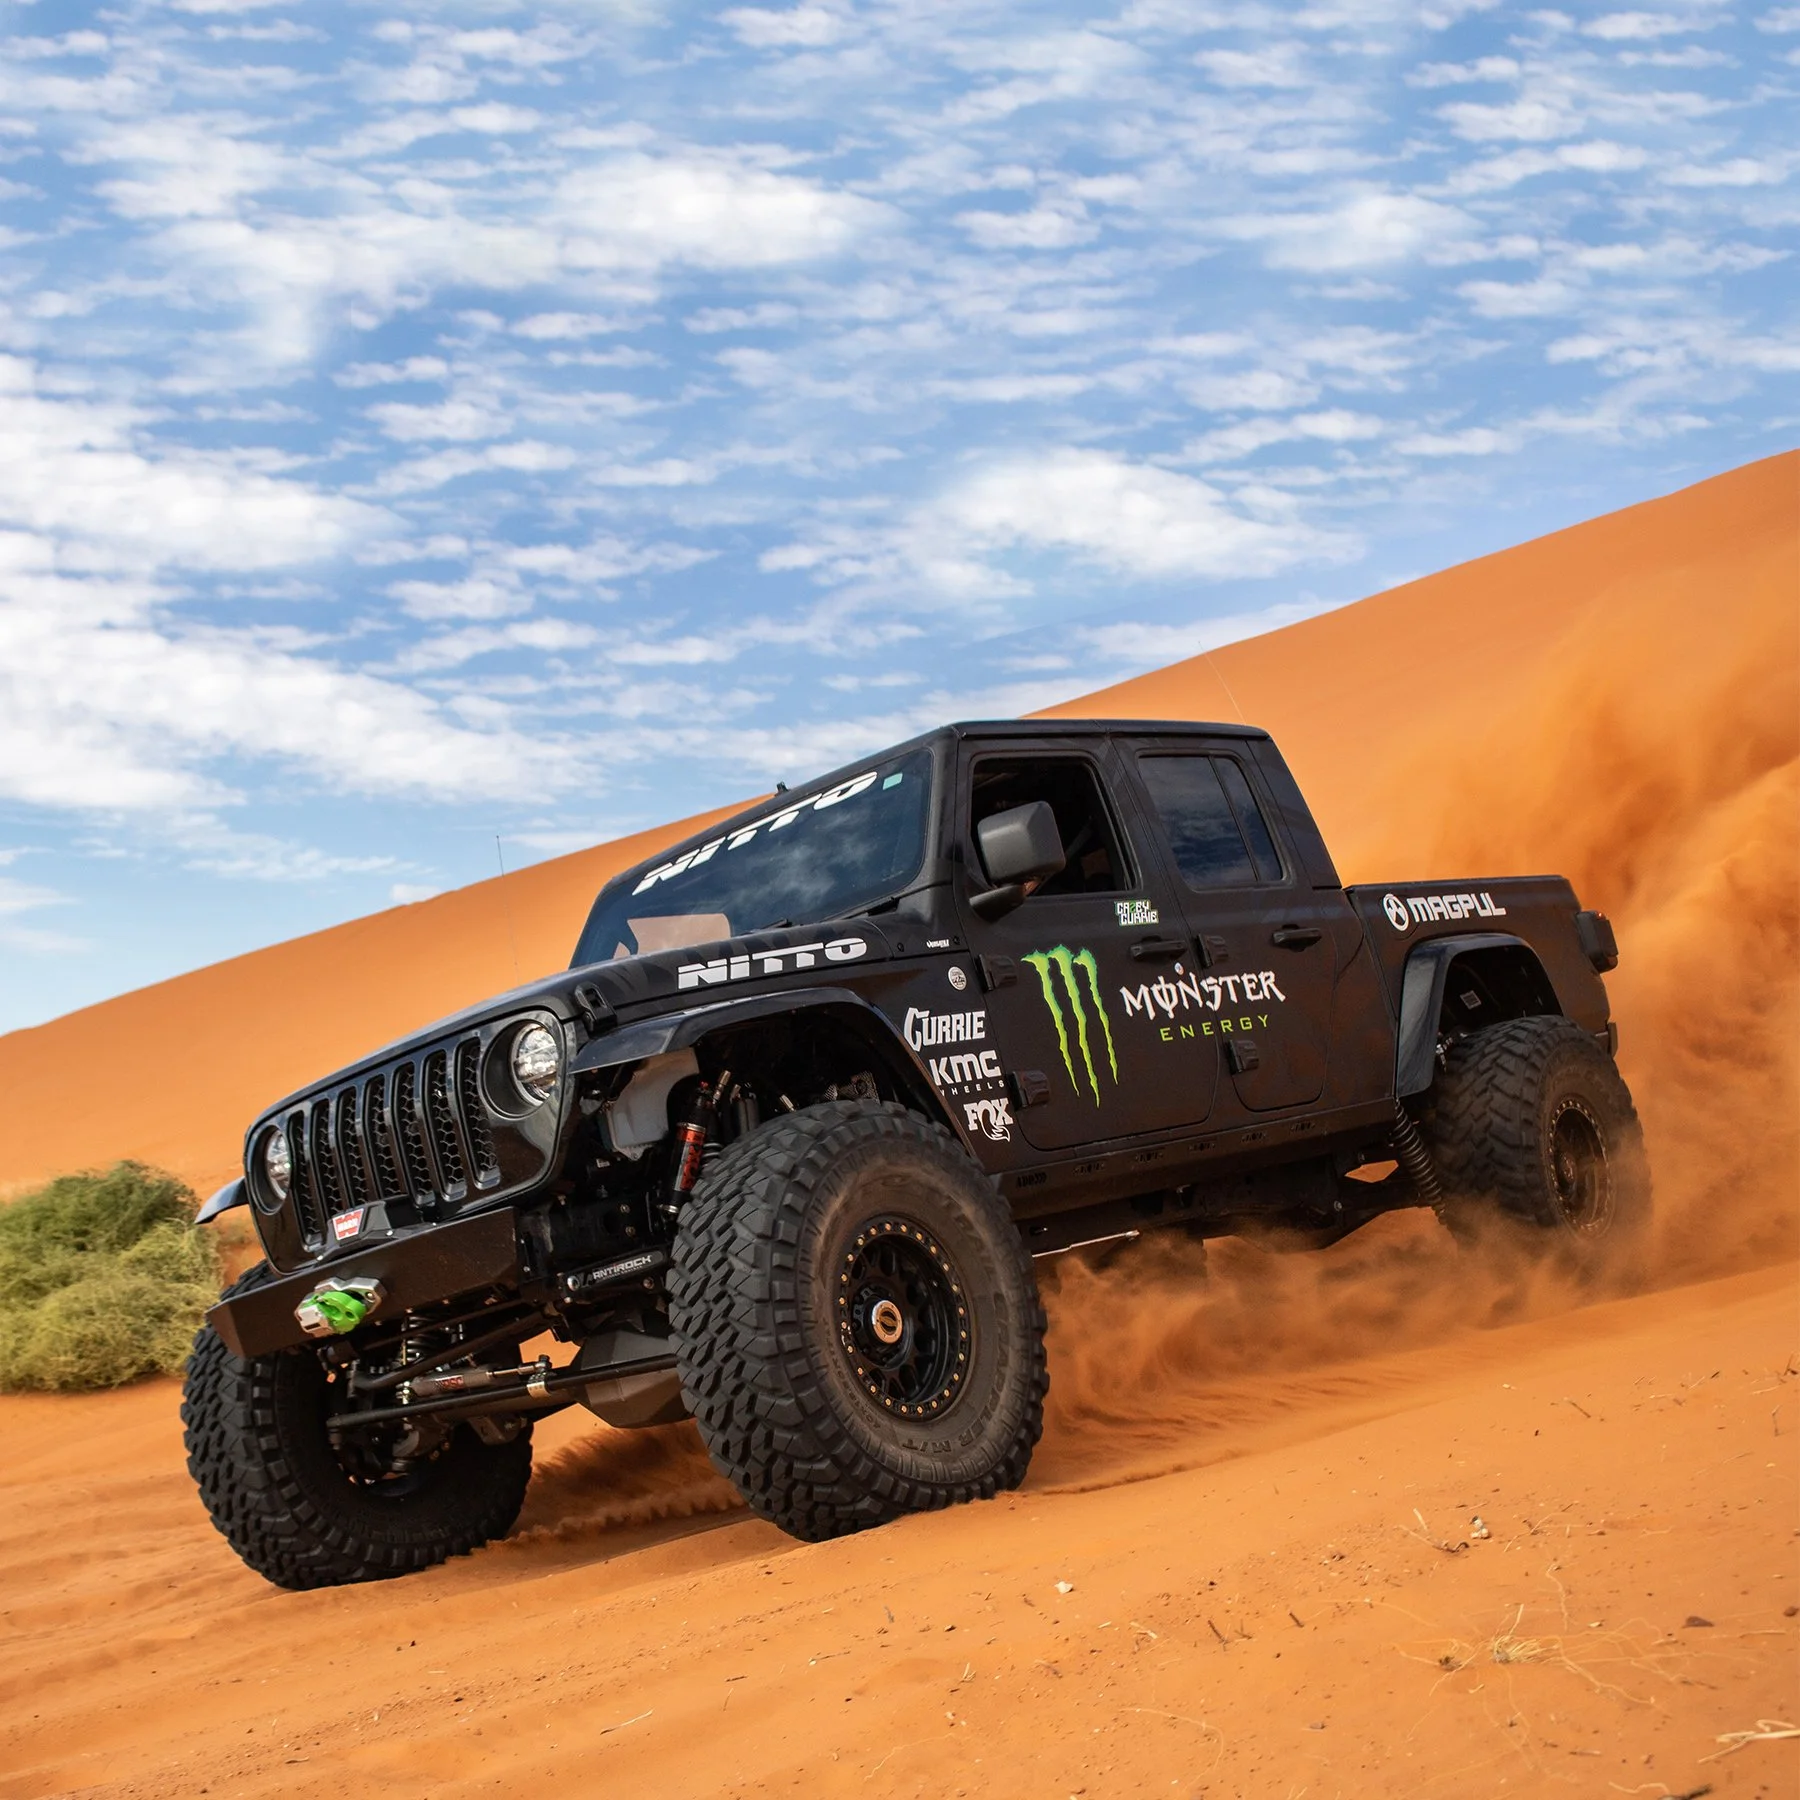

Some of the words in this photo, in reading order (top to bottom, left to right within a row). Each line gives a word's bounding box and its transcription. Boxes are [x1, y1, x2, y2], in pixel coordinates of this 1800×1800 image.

[631, 771, 877, 896] NITTO
[1407, 893, 1506, 922] MAGPUL
[677, 936, 867, 990] NITTO
[1119, 970, 1286, 1021] MONSTER
[903, 1007, 986, 1052] CURRIE
[1160, 1014, 1268, 1042] ENERGY
[928, 1049, 1002, 1086] KMC
[963, 1097, 1014, 1142] FOX
[592, 1254, 652, 1280] ANTIROCK
